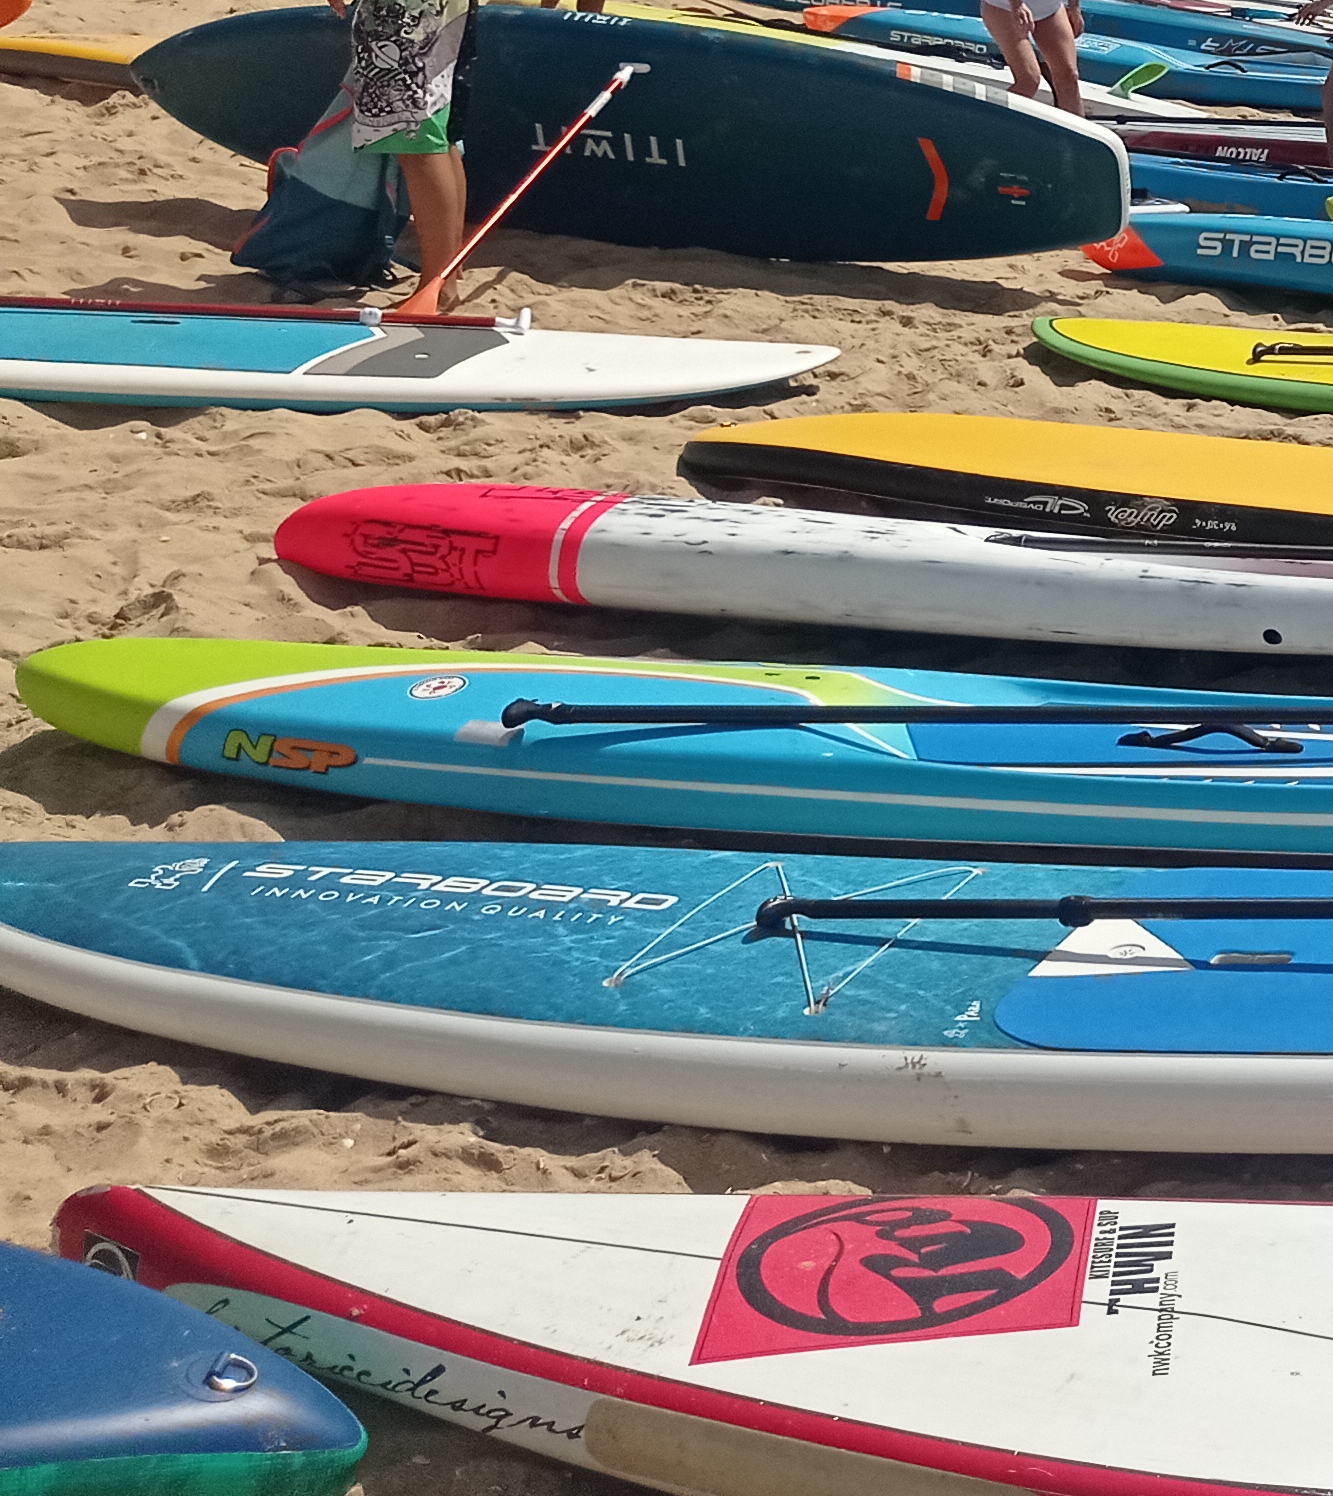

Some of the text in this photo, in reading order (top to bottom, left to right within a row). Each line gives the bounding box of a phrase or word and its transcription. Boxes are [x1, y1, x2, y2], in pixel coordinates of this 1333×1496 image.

[1215, 145, 1269, 163] FALCON
[1104, 503, 1179, 530] drifter
[222, 729, 359, 775] NSP
[242, 862, 679, 911] STARBOARD
[250, 885, 625, 927] INNOVATION QUALITY
[1098, 1209, 1120, 1226] SUP
[1088, 1236, 1114, 1281] KITESURF
[1147, 1270, 1183, 1377] nwkcompany.com
